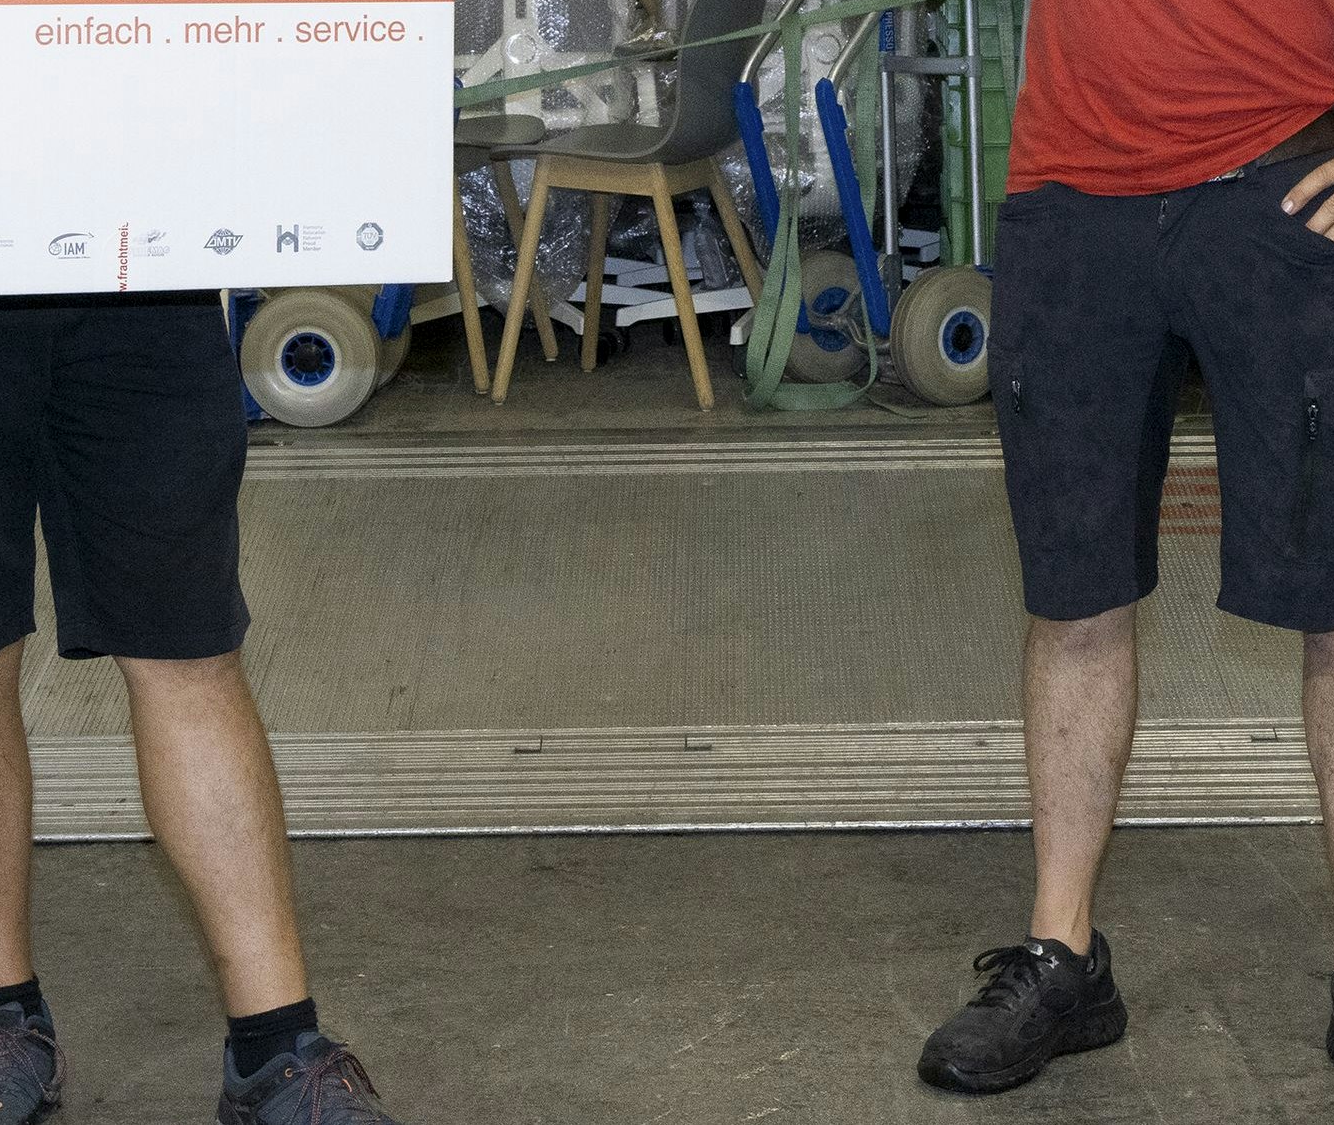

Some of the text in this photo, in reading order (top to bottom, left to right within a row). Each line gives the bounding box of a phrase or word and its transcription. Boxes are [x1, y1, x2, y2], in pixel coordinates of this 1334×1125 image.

[34, 17, 153, 47] einfach
[184, 15, 265, 44] mehr
[295, 14, 407, 44] service
[64, 242, 85, 256] IAM
